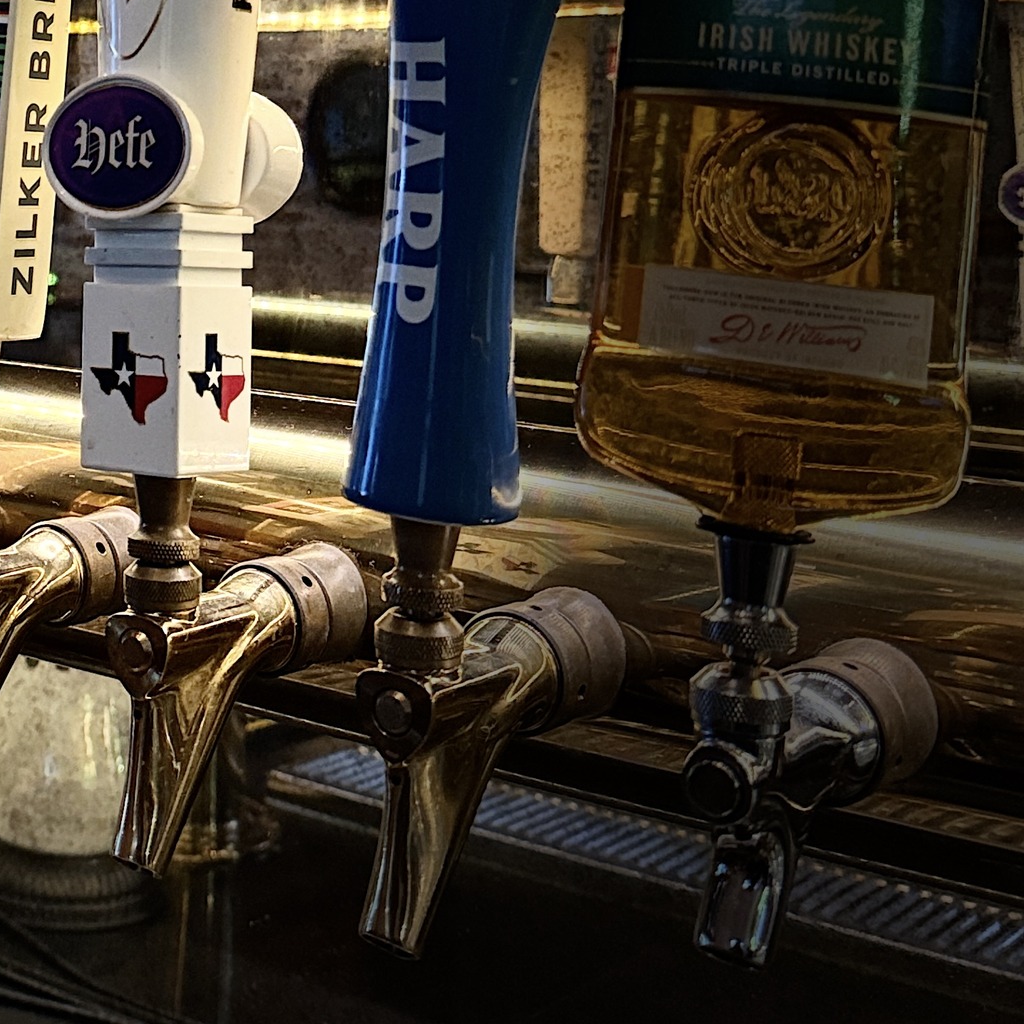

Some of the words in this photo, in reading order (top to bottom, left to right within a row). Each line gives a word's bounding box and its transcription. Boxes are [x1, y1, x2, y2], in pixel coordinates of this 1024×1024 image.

[697, 20, 775, 53] IRISH
[716, 55, 783, 76] TRIPLE
[791, 63, 891, 88] DISTILLED
[71, 115, 157, 176] Hefe
[10, 103, 48, 295] ZILKER
[378, 36, 446, 325] HARP
